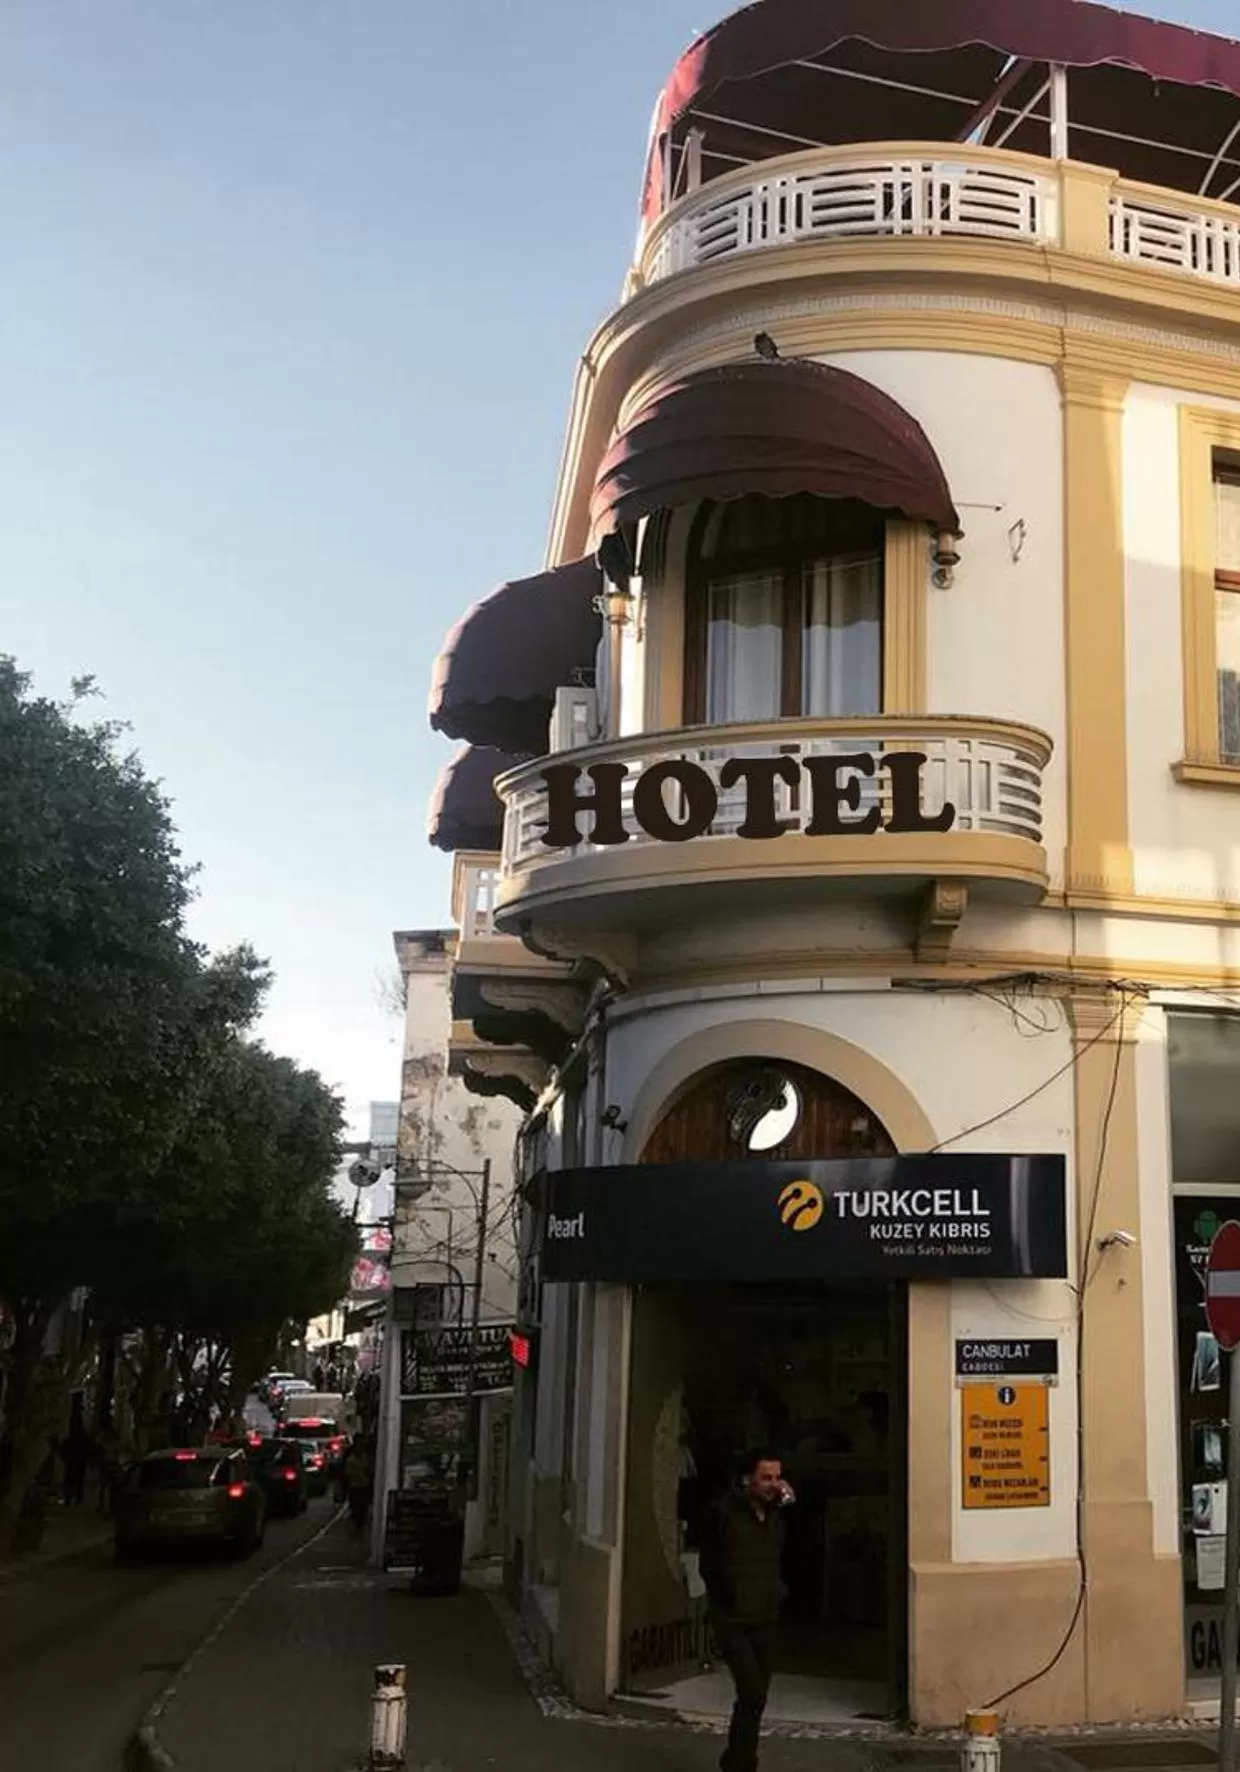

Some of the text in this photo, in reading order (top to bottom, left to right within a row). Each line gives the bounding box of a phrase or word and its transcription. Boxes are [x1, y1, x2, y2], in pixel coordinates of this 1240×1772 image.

[540, 752, 955, 846] HOTEL
[833, 1188, 990, 1219] TURKCELL
[548, 1212, 585, 1239] Pearl
[870, 1221, 991, 1240] KUZEY KIBRIS
[961, 1343, 1031, 1359] CANBULAT
